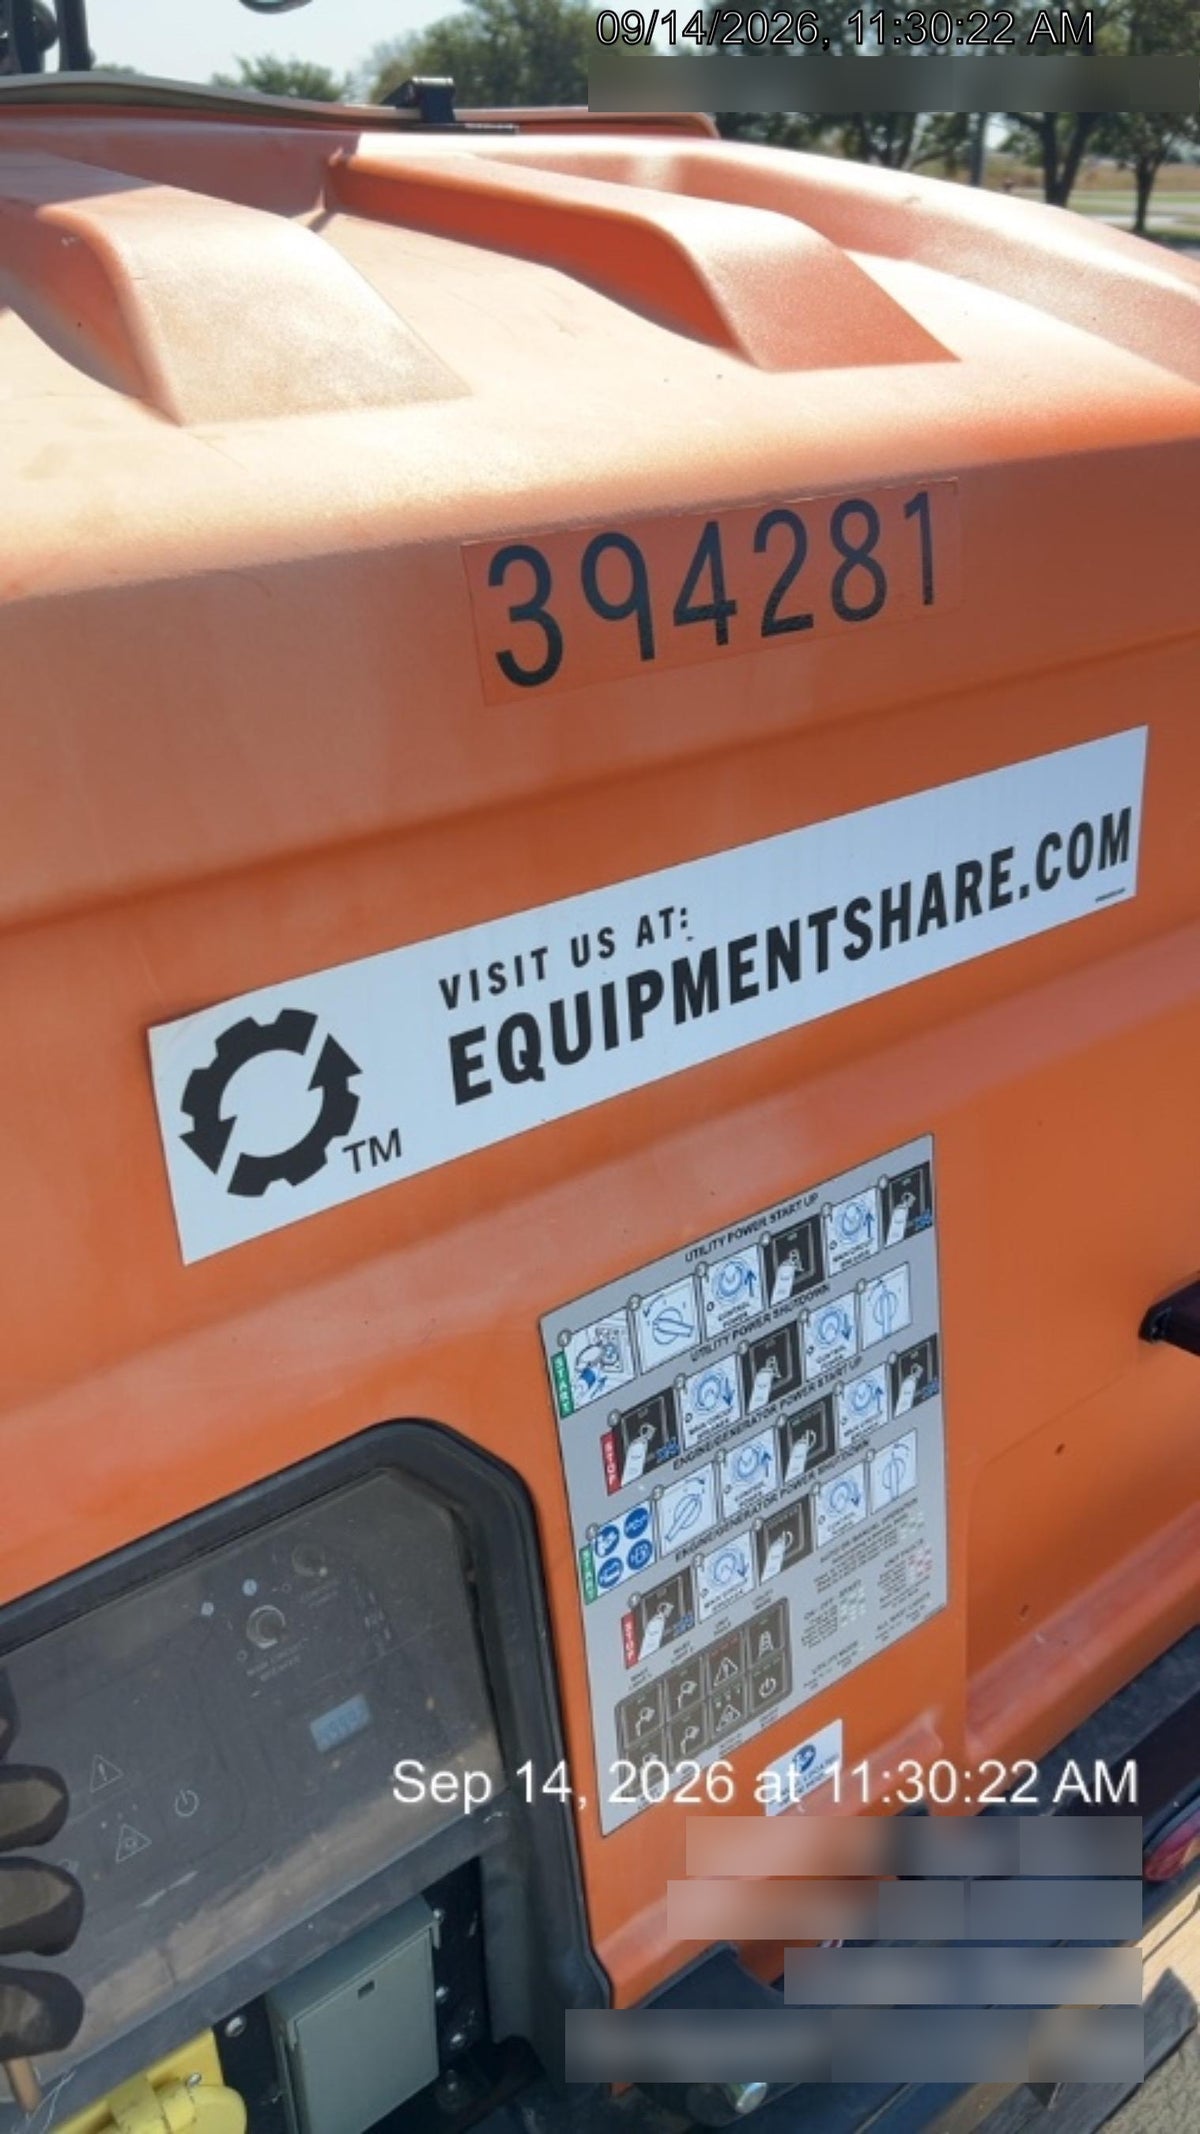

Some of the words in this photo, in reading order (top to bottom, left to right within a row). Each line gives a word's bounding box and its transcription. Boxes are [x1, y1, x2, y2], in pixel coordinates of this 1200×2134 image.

[487, 491, 934, 688] 394281
[438, 946, 548, 1010] VISIT
[570, 926, 615, 969] US
[635, 905, 690, 948] AT:
[447, 806, 1132, 1106] EQUIPMENTSHARE.COM
[342, 1127, 402, 1174] TM
[685, 1235, 725, 1262] UTILITY
[728, 1218, 767, 1242] POWER
[769, 1200, 802, 1224] START
[803, 1192, 819, 1207] UP
